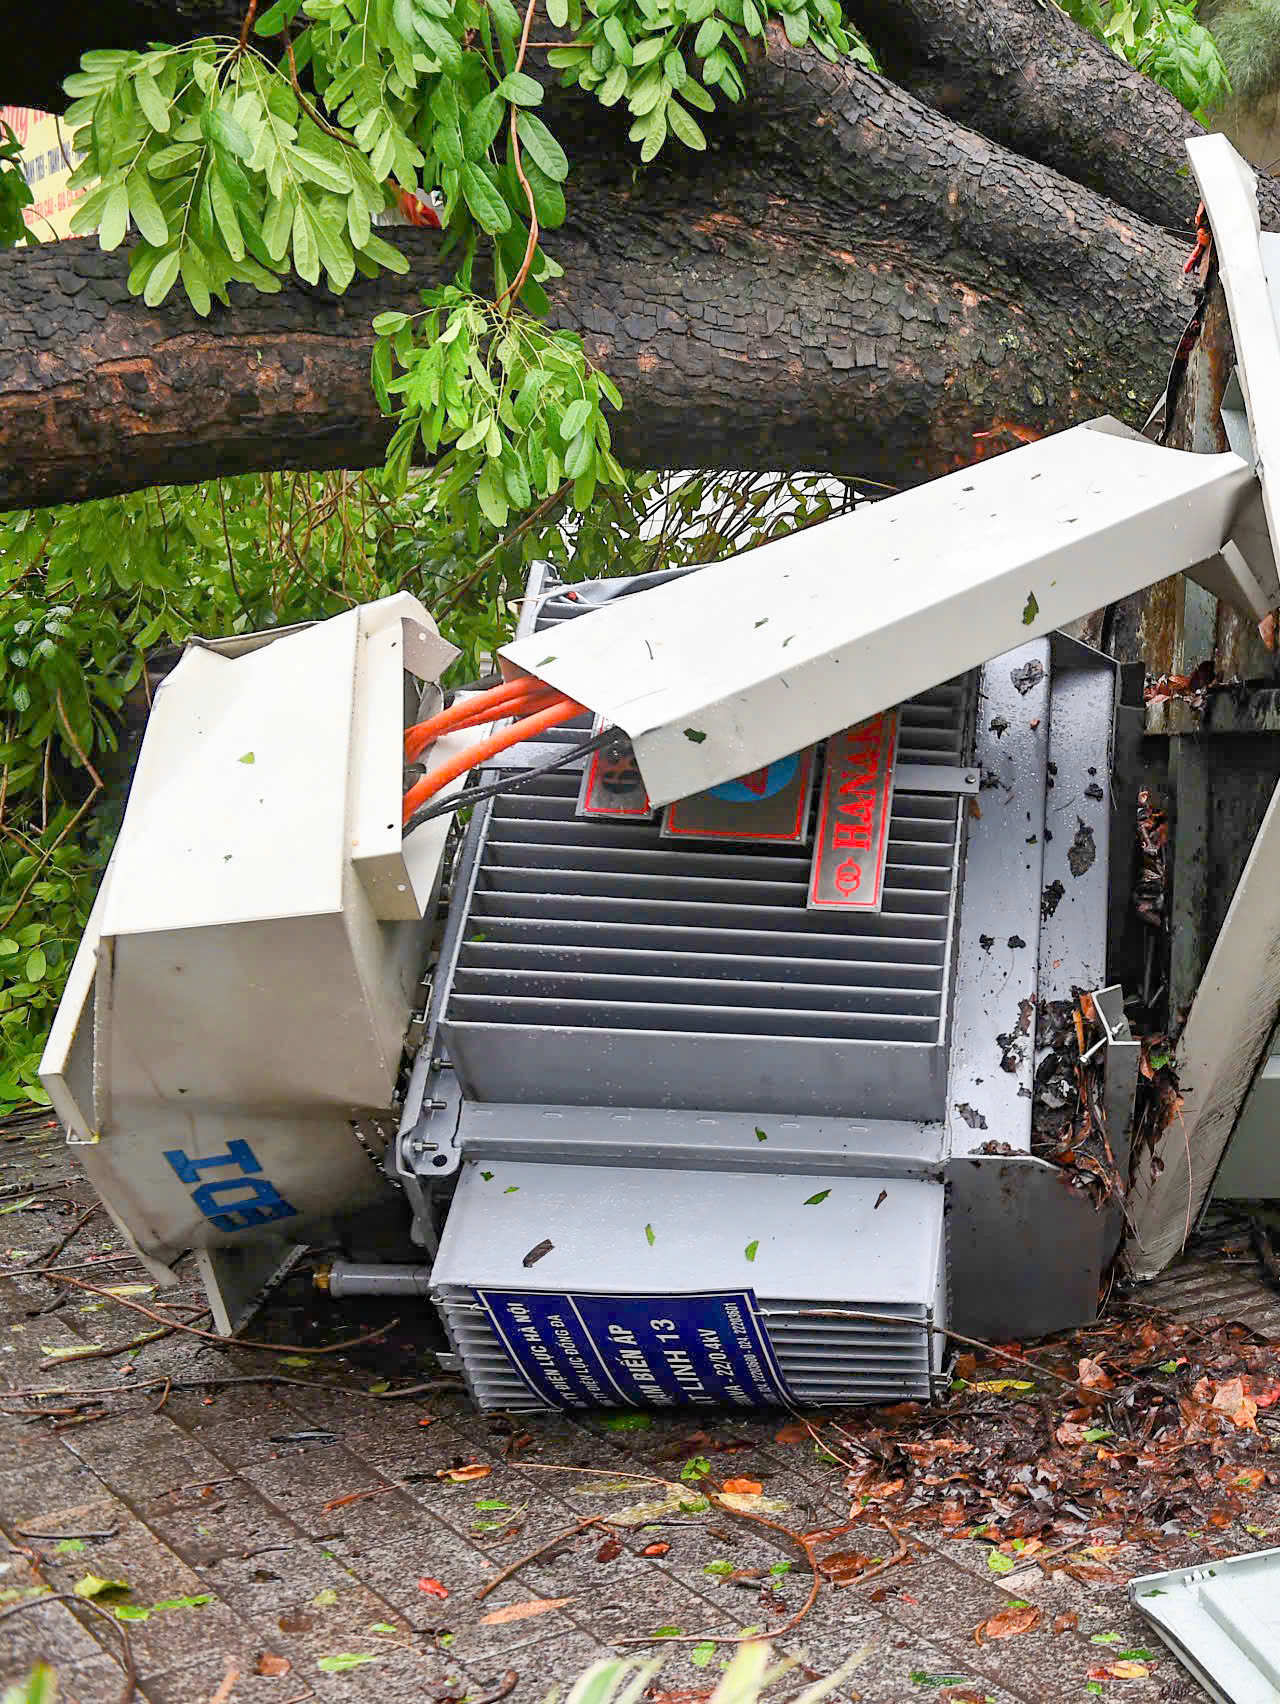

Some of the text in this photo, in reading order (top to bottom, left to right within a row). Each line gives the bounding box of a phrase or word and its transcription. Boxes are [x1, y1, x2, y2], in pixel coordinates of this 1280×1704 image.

[507, 1302, 532, 1323] NỘI
[547, 1315, 565, 1327] ĐA
[518, 1326, 542, 1342] HÀ
[607, 1324, 638, 1345] ÁP
[650, 1319, 680, 1343] 13
[530, 1345, 555, 1366] LỰC
[616, 1349, 655, 1381] BIẾN
[544, 1369, 571, 1390] ĐIỆN
[663, 1350, 704, 1391] LINH
